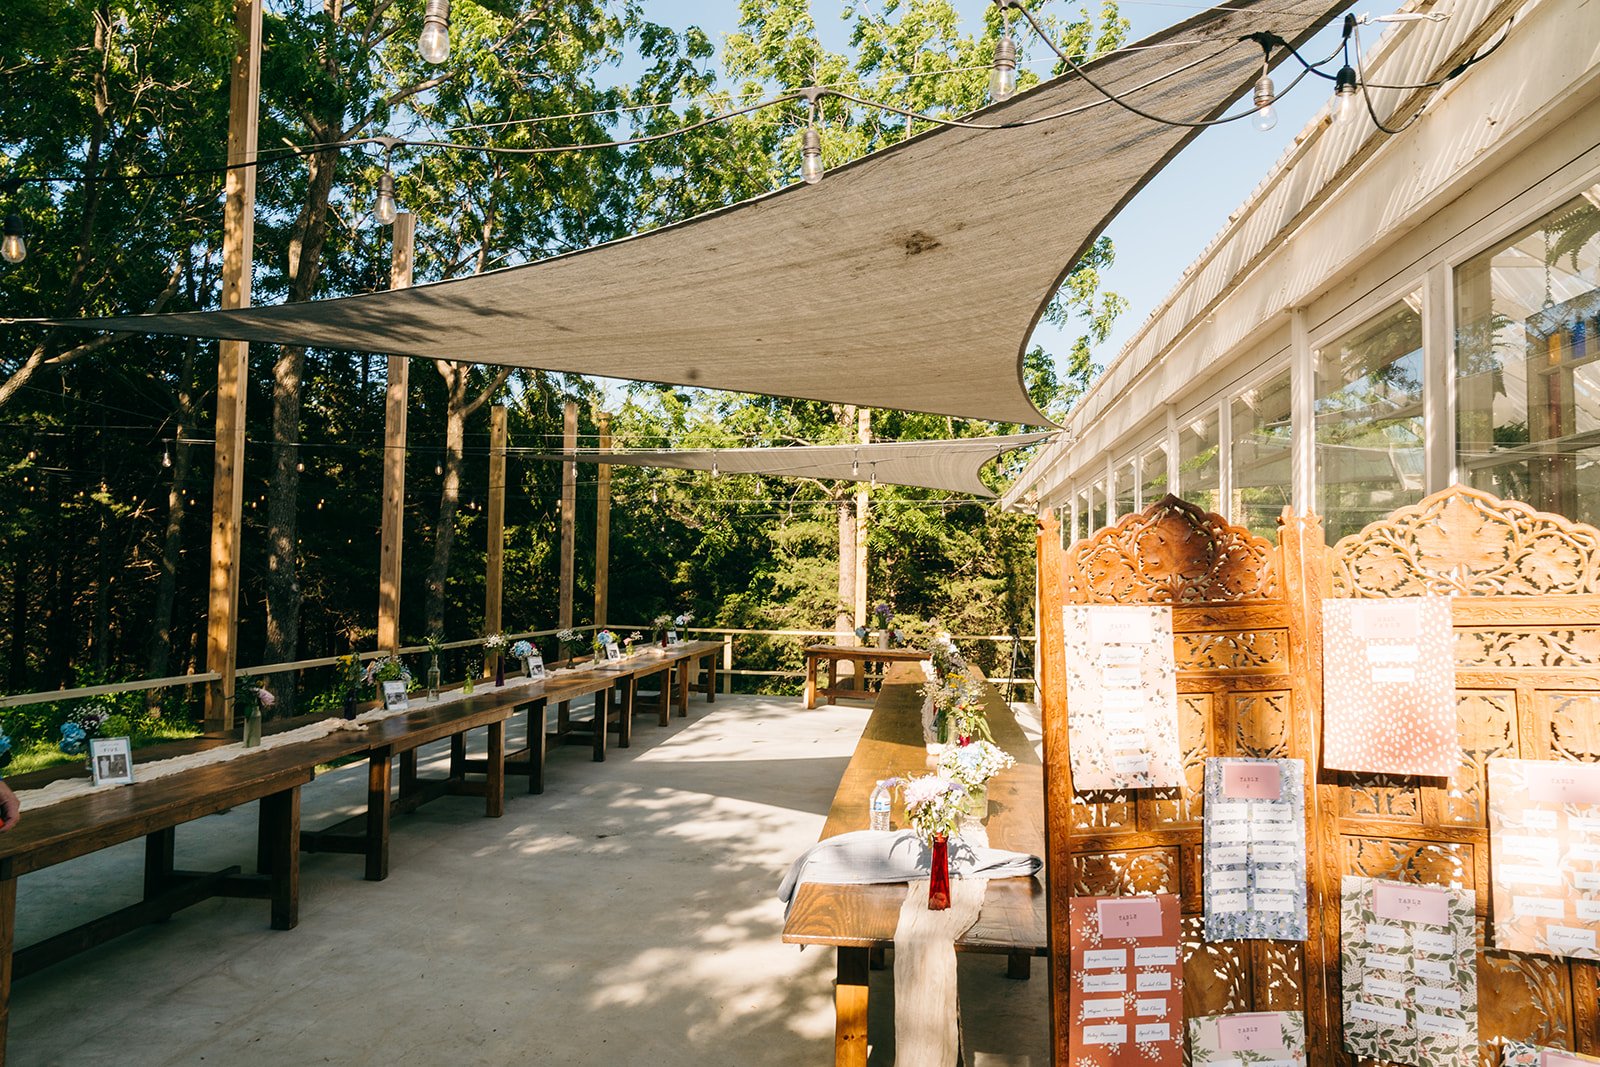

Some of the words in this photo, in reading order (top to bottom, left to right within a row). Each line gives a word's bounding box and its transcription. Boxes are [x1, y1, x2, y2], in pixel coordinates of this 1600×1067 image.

[1397, 897, 1422, 906] TABLE
[1118, 913, 1138, 921] TABLE
[1237, 1026, 1258, 1034] TABLE
